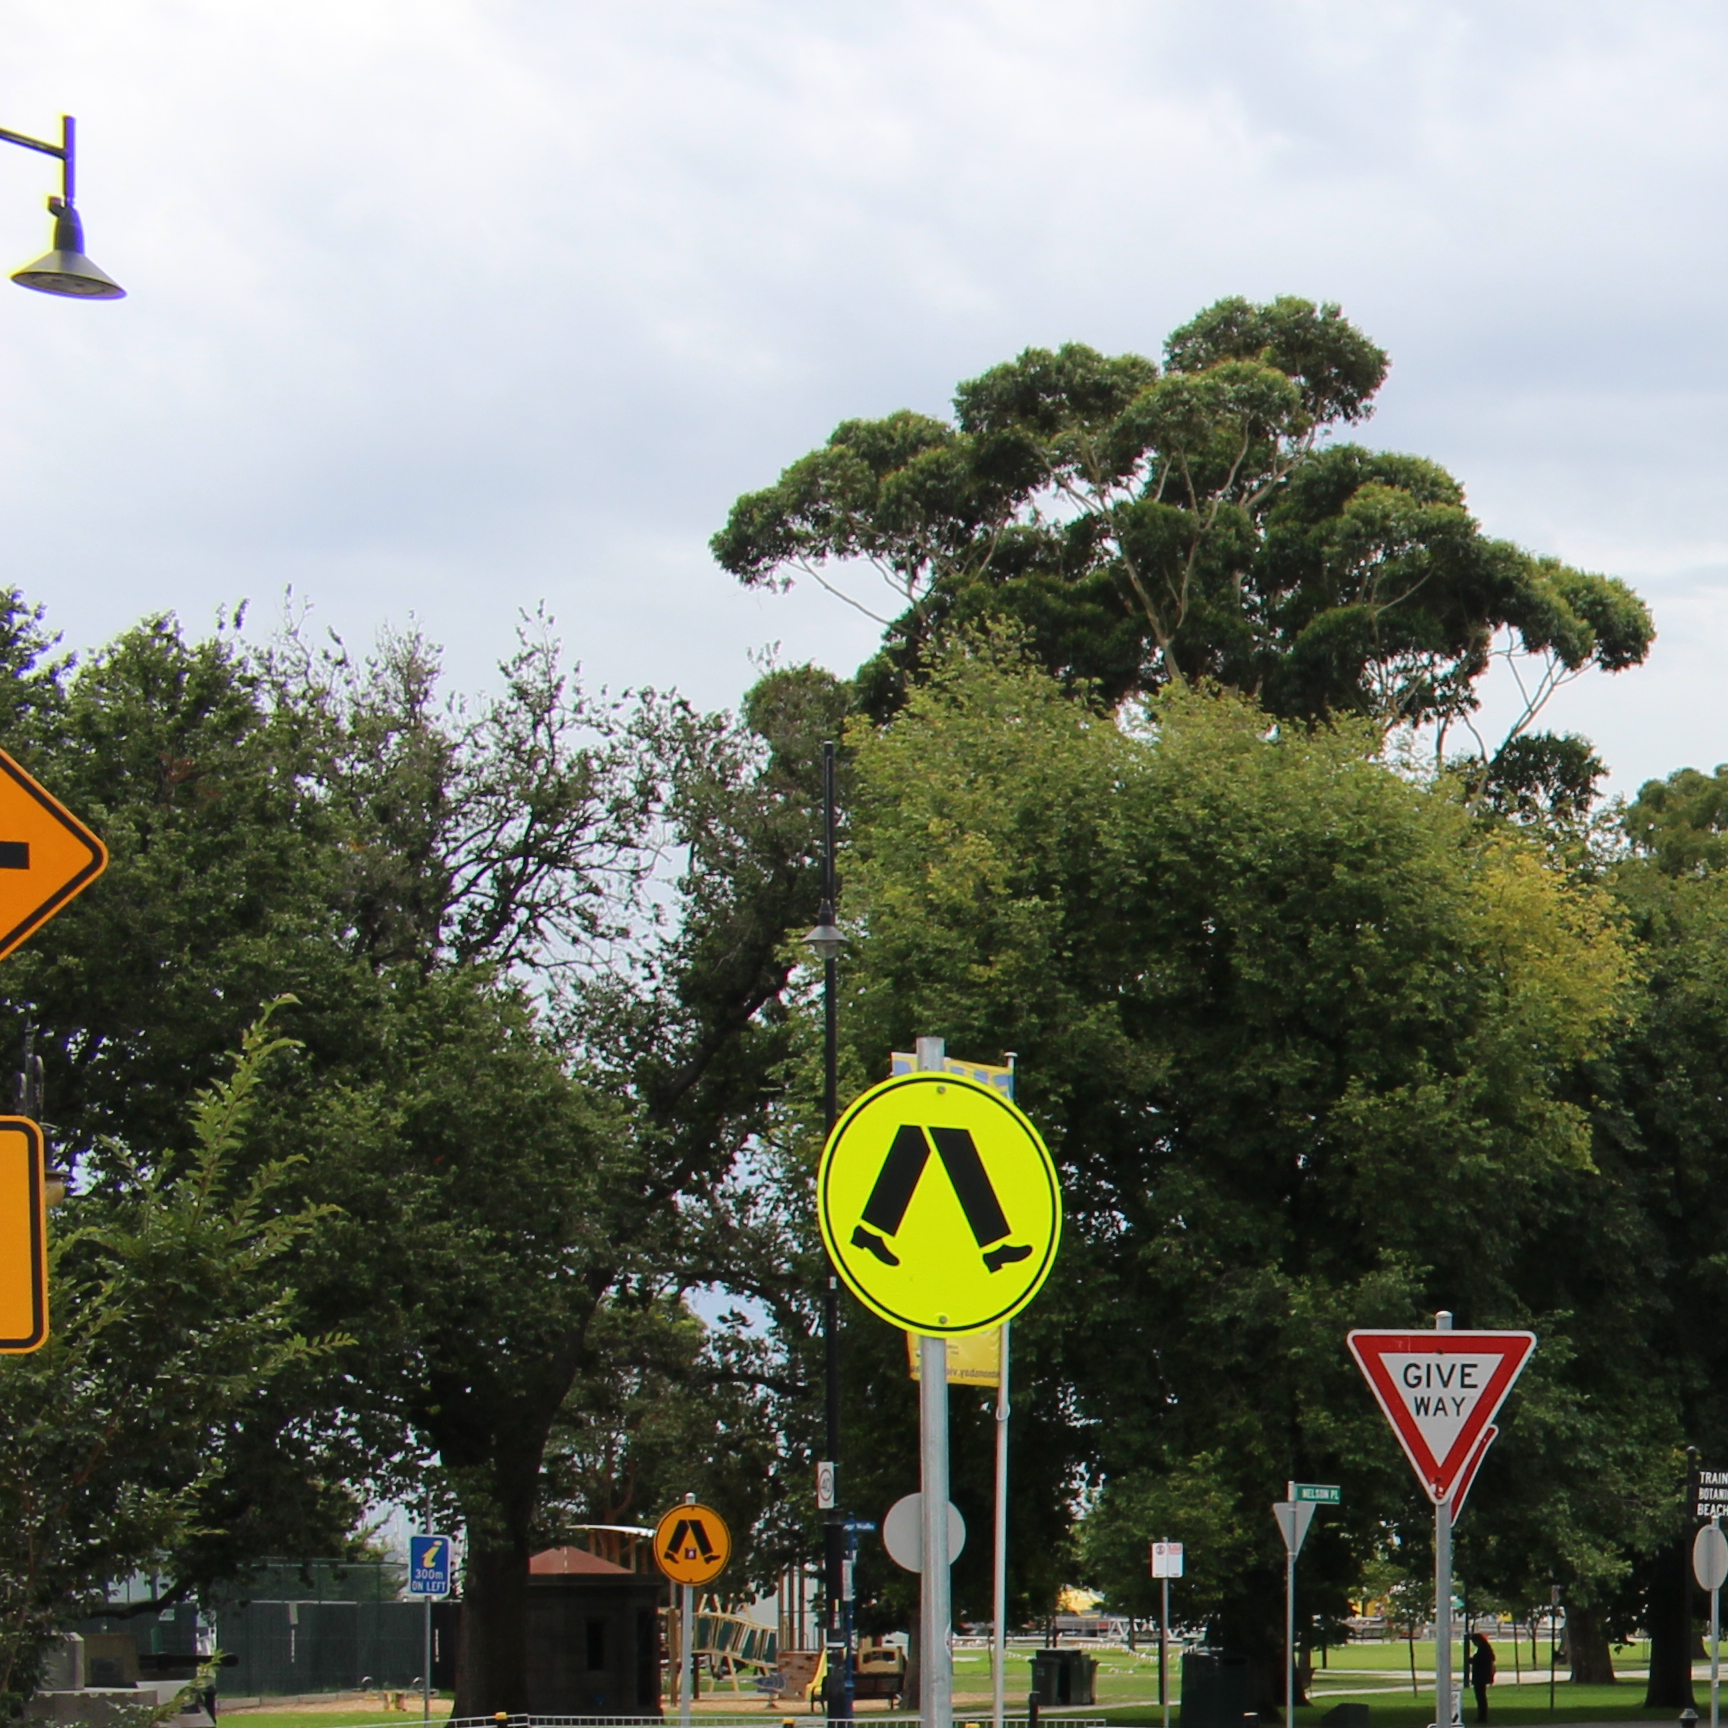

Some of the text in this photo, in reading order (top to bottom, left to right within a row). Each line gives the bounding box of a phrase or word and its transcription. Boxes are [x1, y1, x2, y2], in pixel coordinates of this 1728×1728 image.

[1403, 1363, 1478, 1389] GIVE
[1414, 1396, 1466, 1417] WAY
[1700, 1471, 1728, 1485] TRAIN
[415, 1569, 443, 1580] 300m
[412, 1581, 446, 1592] ON LEFT
